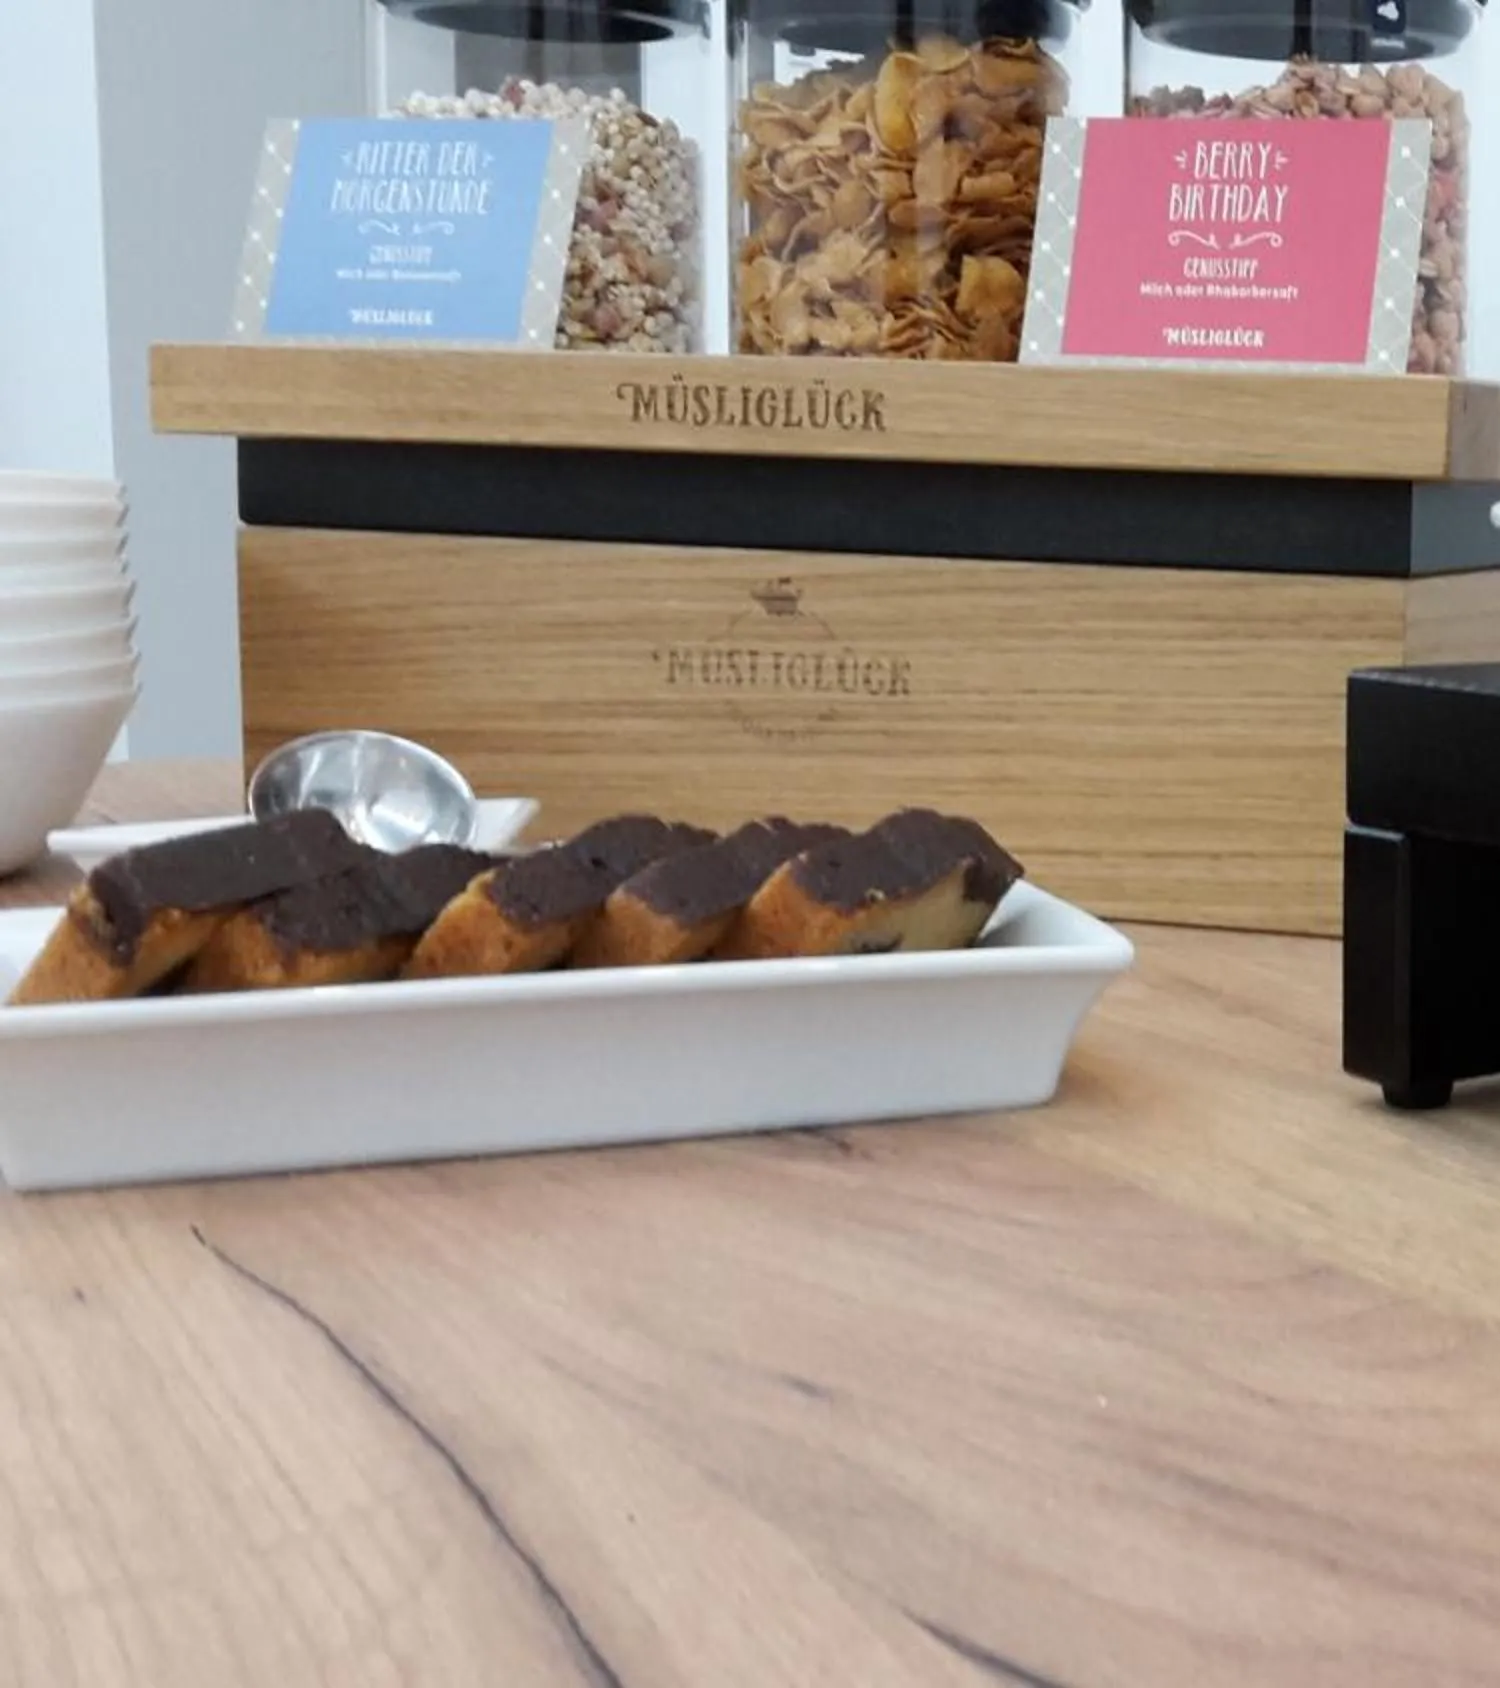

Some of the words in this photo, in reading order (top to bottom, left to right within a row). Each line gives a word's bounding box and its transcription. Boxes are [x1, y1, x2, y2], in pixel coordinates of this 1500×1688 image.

[356, 141, 431, 175] RITTER
[437, 141, 478, 175] DER
[1194, 140, 1272, 180] BERRY
[330, 178, 491, 214] MORGENSTUNDE
[1168, 183, 1288, 223] BIRTHDAY
[1183, 256, 1258, 279] GENUSSTIPP
[1139, 281, 1173, 297] Milch
[1175, 283, 1204, 298] oder
[1162, 326, 1264, 348] MÜSLIGLÜCK
[616, 374, 887, 432] MÜSLIGLÜCK
